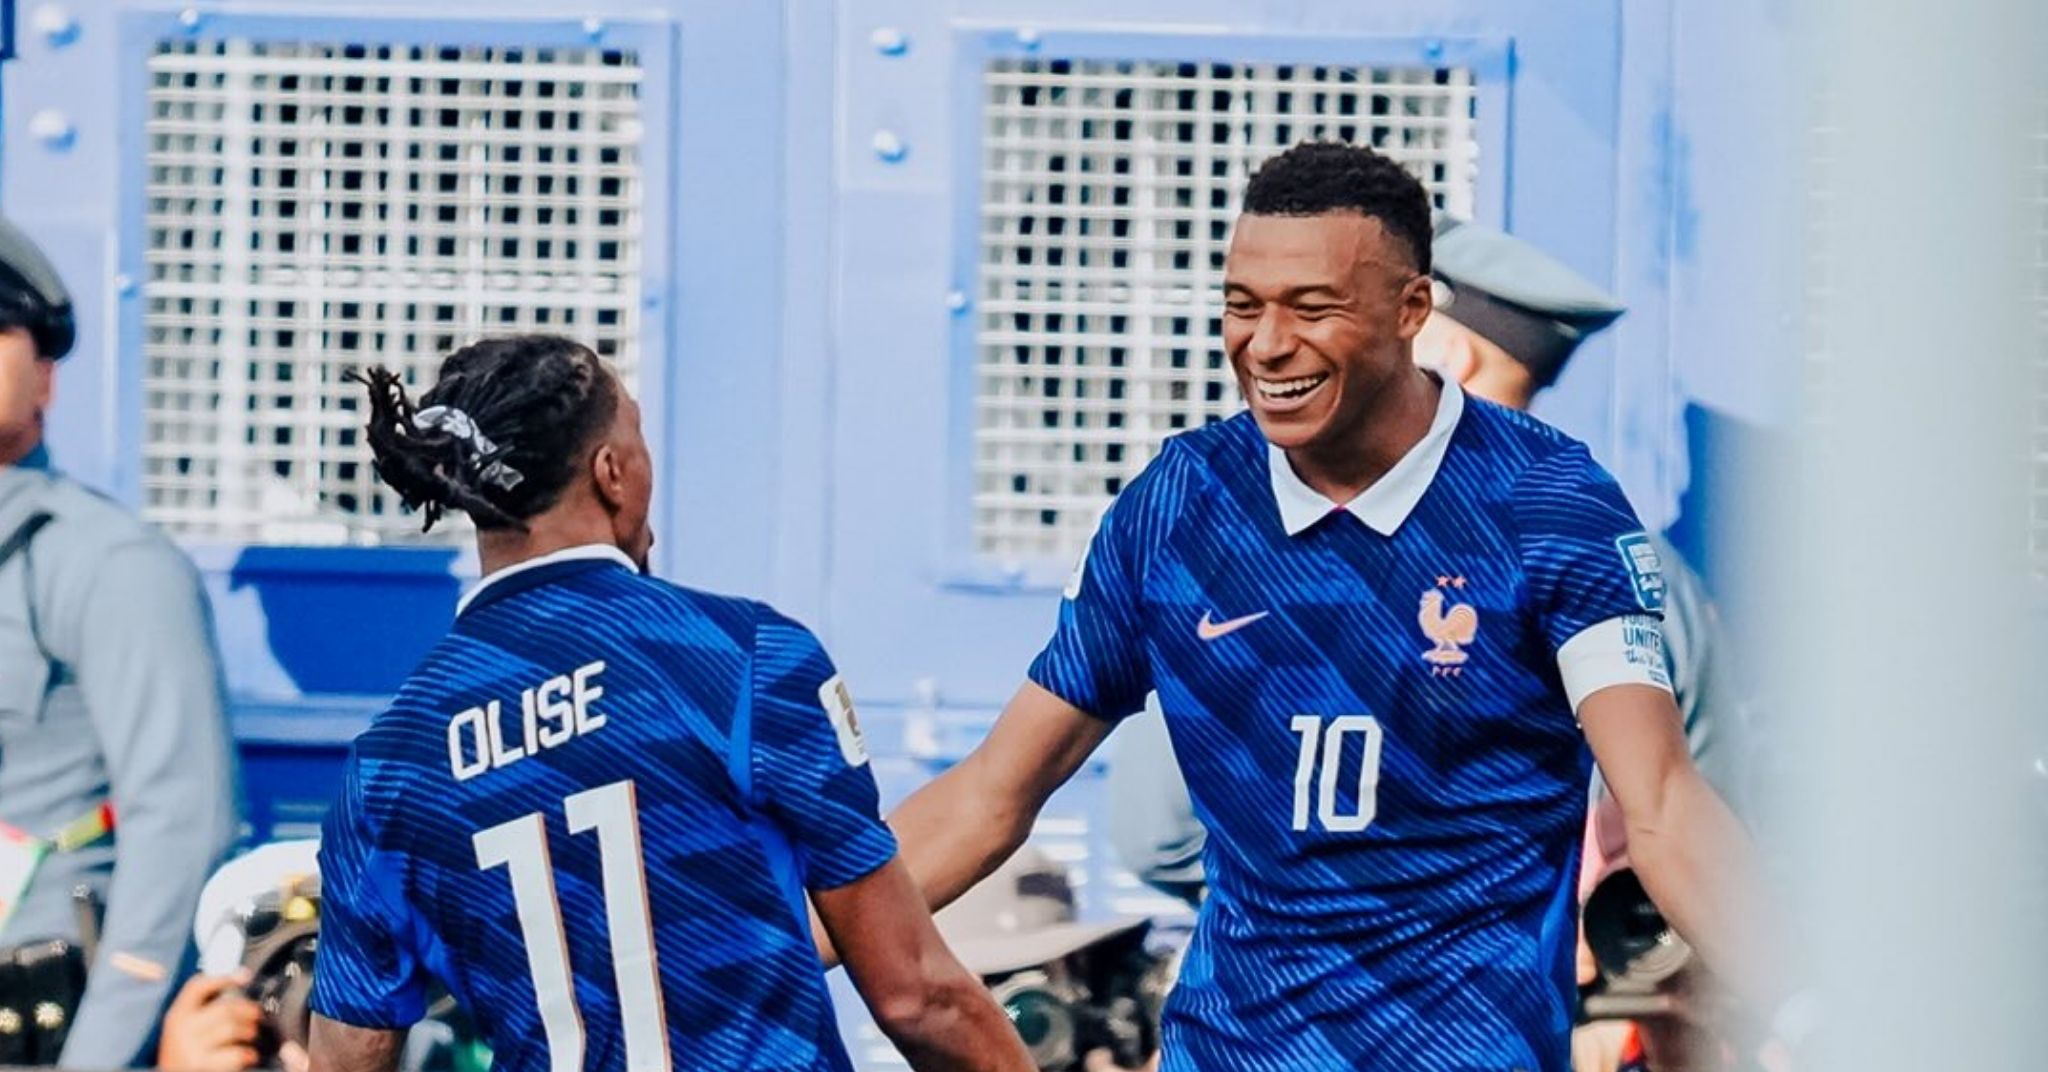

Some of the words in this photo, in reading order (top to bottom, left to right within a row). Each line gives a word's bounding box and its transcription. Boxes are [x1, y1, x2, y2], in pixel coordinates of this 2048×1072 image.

[448, 660, 607, 781] OLISE
[1291, 714, 1382, 832] 10
[472, 779, 673, 1072] 11
